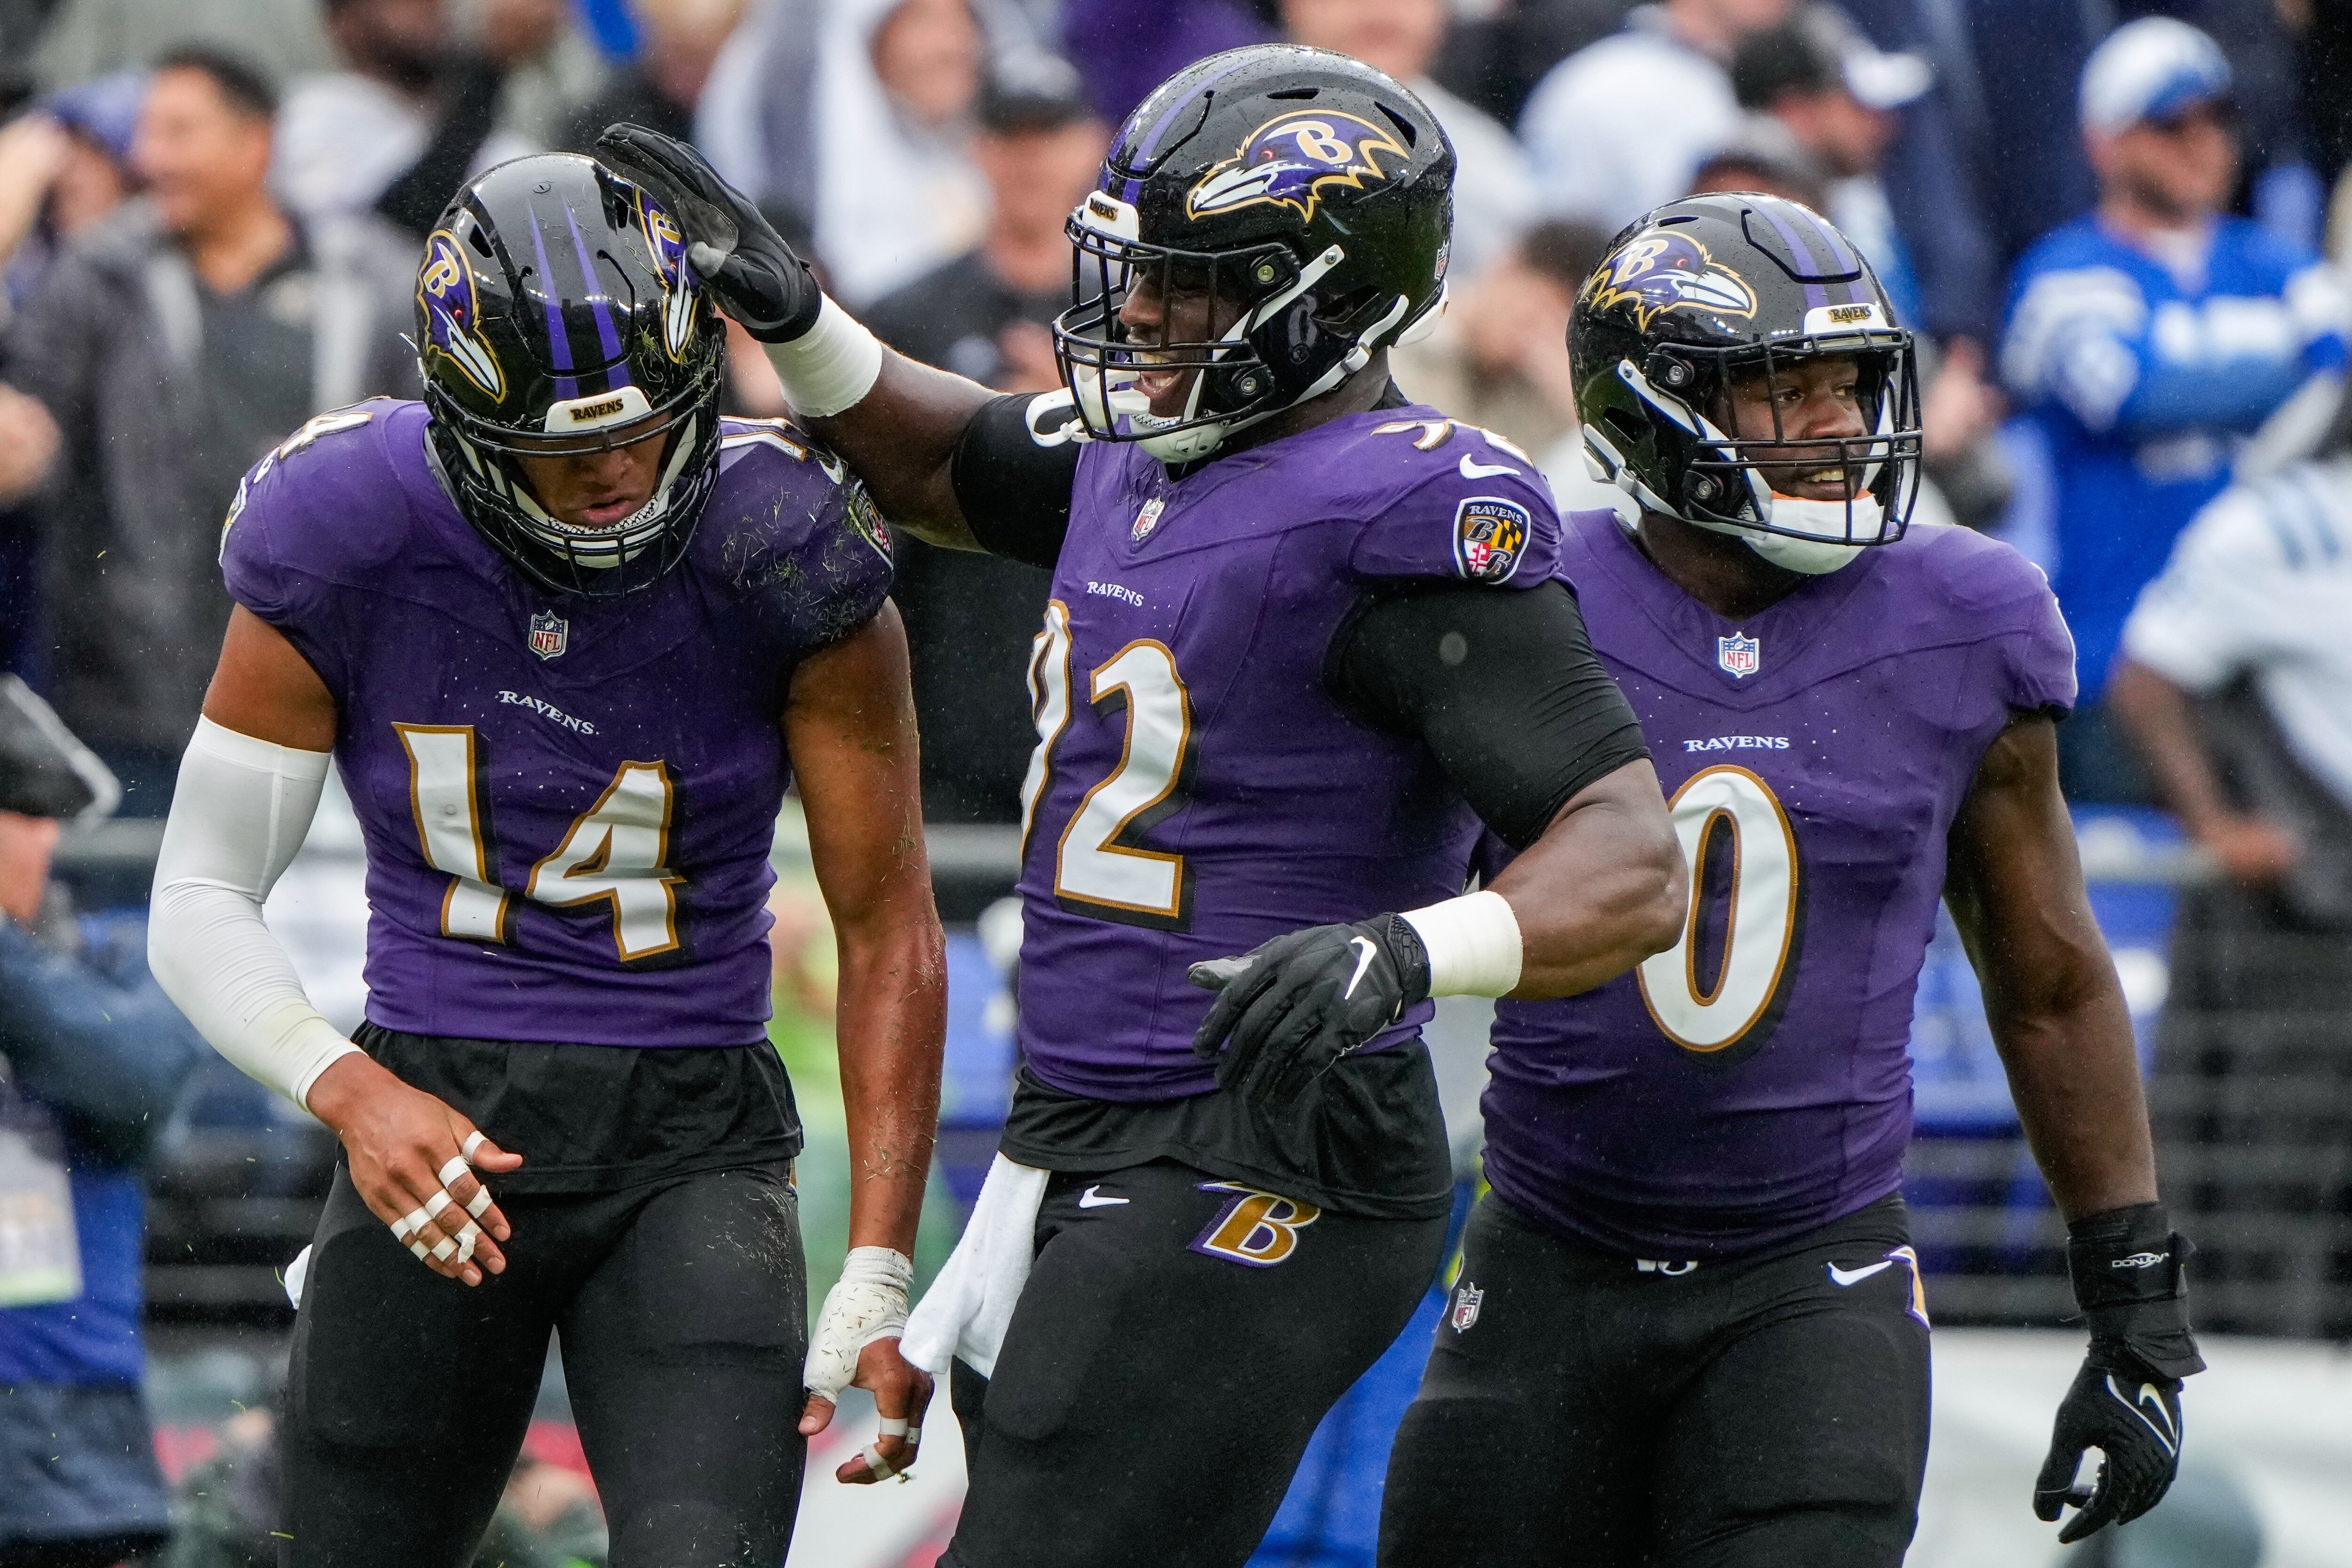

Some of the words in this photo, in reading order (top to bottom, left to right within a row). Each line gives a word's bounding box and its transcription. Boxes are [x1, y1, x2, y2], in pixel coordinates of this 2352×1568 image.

[1828, 306, 1872, 323] RAVENS
[569, 397, 624, 422] RAVENS
[1469, 506, 1523, 524] RAVENS
[1086, 581, 1144, 607] RAVENS
[534, 632, 560, 651] NFL
[1727, 652, 1752, 669] NFL
[499, 690, 595, 734] RAVENS
[1683, 736, 1790, 752] RAVENS
[391, 721, 687, 962] 14
[1637, 764, 1798, 1052] 0
[2112, 1253, 2169, 1267] DONJOY
